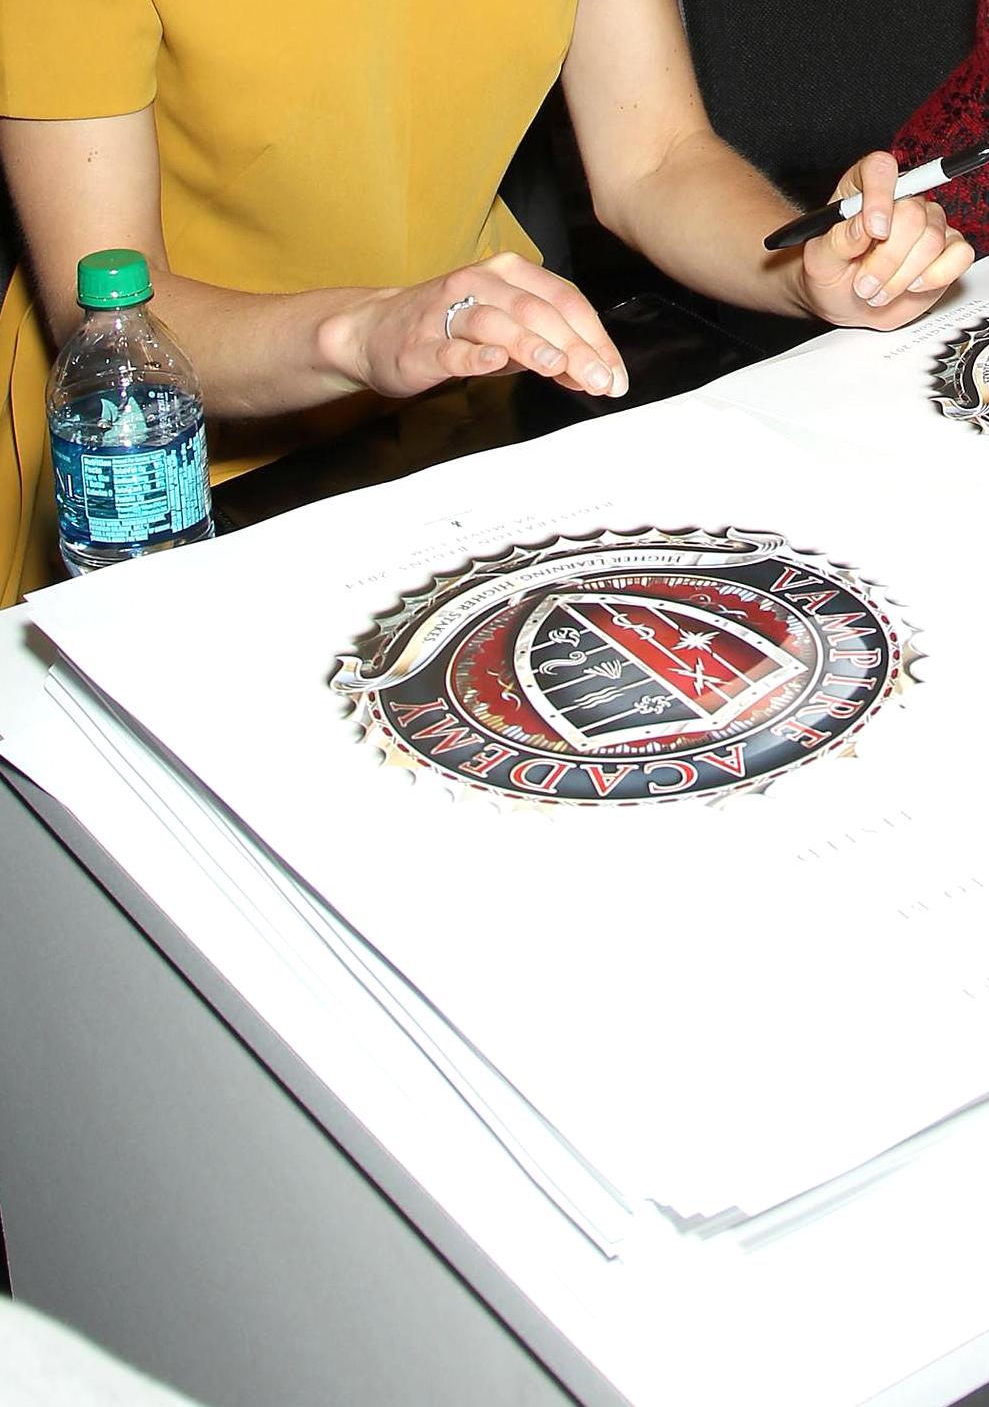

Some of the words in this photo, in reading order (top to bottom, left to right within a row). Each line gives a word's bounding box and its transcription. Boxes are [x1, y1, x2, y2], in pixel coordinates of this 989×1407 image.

[611, 554, 682, 566] HIGHER
[460, 581, 516, 611] HIGHER
[768, 566, 881, 748] VAMPIRE
[390, 696, 748, 797] ACADEMY
